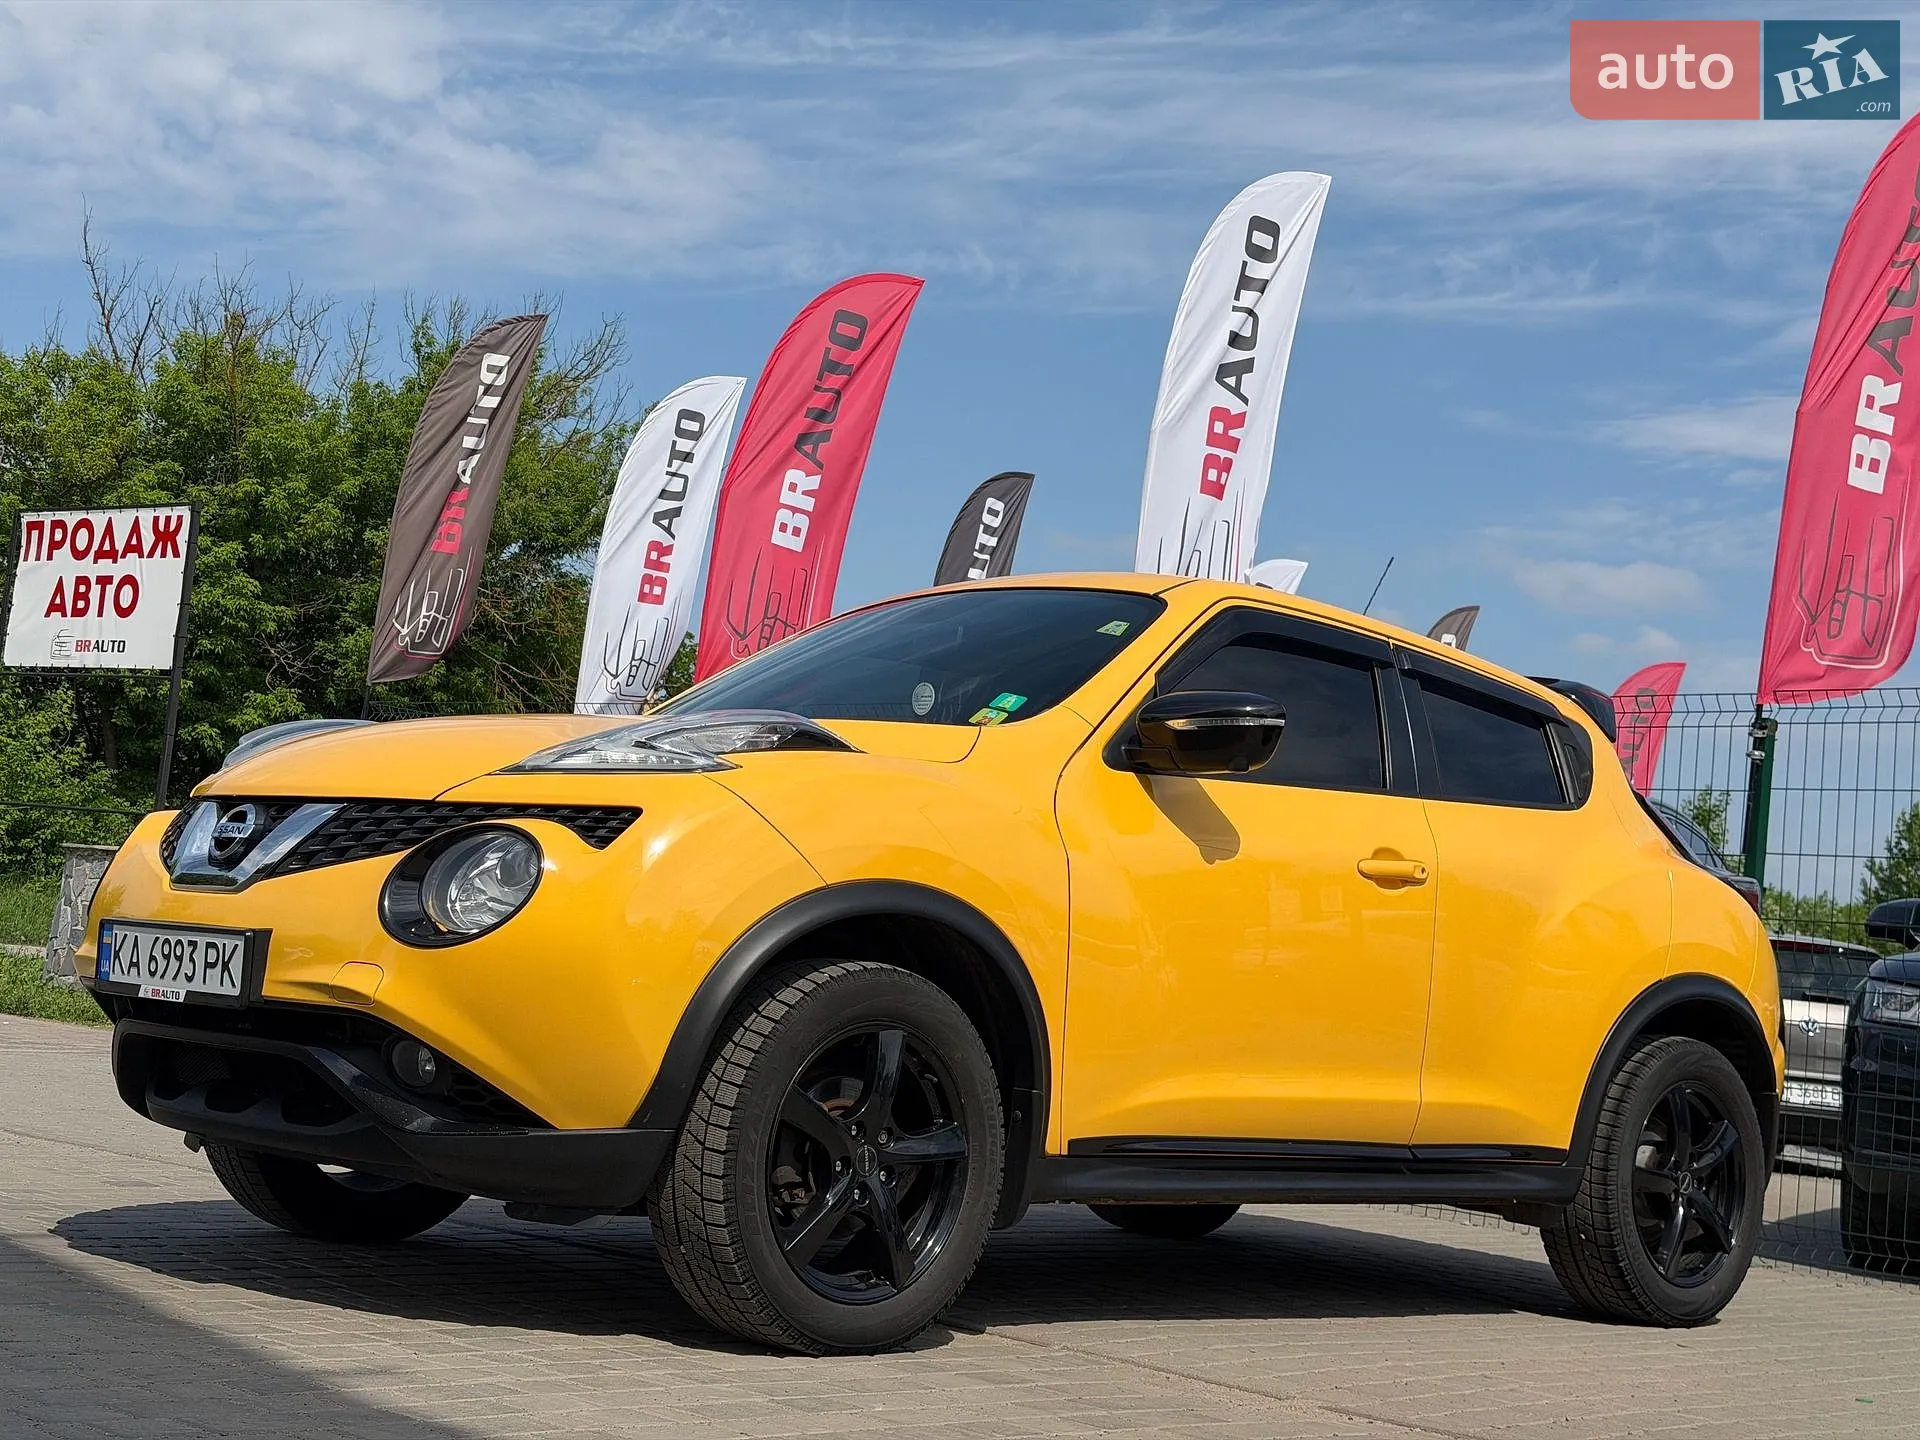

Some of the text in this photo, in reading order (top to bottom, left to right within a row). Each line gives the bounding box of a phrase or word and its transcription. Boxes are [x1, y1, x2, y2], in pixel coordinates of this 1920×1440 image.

[1847, 160, 1920, 494] BRAUT
[1199, 215, 1281, 501] BRAUTO
[429, 353, 511, 554] BRAUTO
[771, 309, 869, 552] BRAUTO
[637, 408, 705, 606] BRAUTO
[23, 515, 183, 564] ПРОДАЖ
[44, 574, 139, 618] АВТО
[75, 639, 126, 653] BRAUTO
[213, 824, 245, 835] SSAN
[101, 960, 109, 972] UA
[112, 932, 239, 989] KA 6993 PK
[151, 988, 180, 1000] BRAUTO
